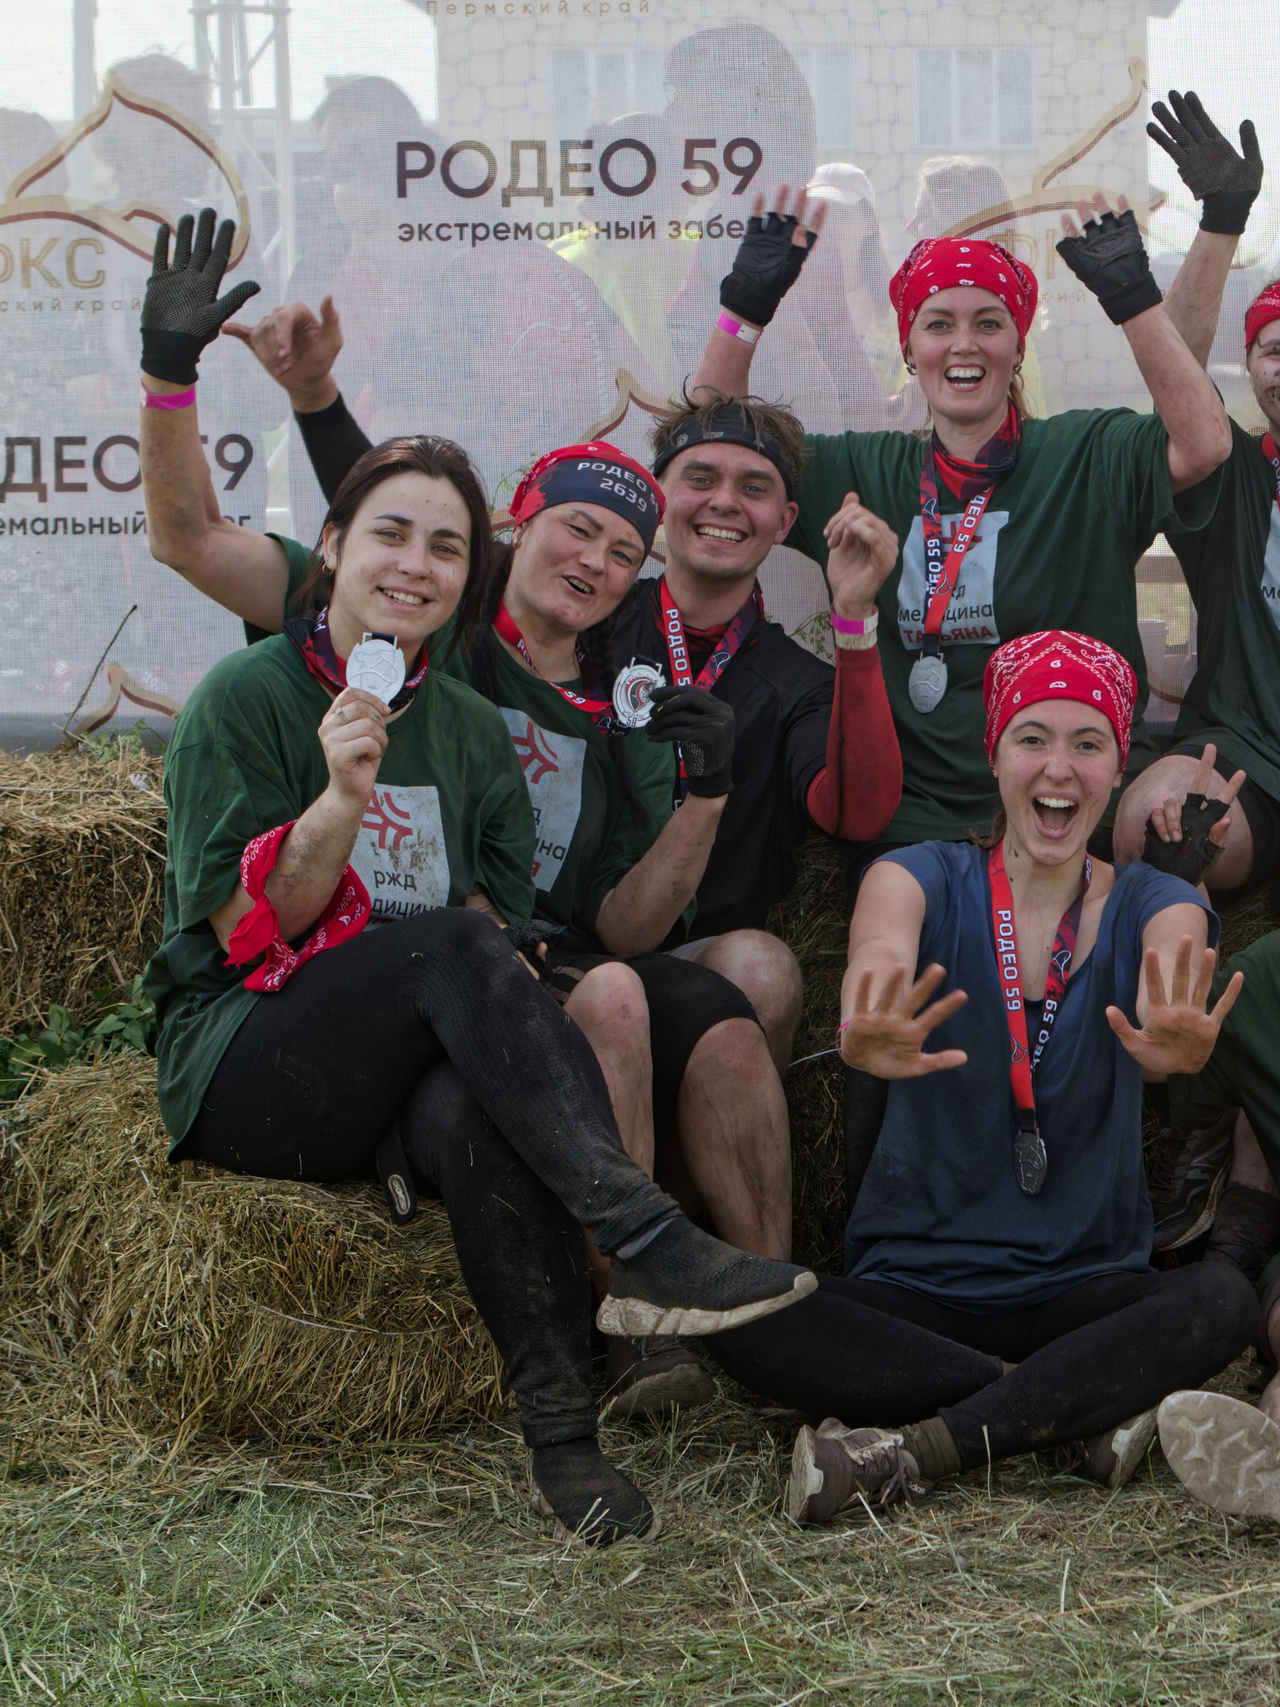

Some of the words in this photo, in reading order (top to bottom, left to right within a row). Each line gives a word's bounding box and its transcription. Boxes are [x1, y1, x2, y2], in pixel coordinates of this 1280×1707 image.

[426, 0, 569, 17] Пермский
[582, 0, 650, 17] край
[396, 138, 657, 207] РОДЕО
[681, 137, 763, 197] 59
[397, 214, 656, 247] экстремальный
[668, 213, 745, 240] забе
[0, 237, 106, 290] КС
[75, 297, 141, 315] край
[0, 434, 144, 502] ДЕО
[577, 462, 647, 492] РОДЕО
[600, 477, 648, 513] 2639
[927, 538, 941, 557] 59
[953, 532, 970, 554] 59
[898, 603, 993, 623] мецина
[666, 608, 689, 672] РОДЕО
[904, 626, 994, 644] ТАЬЯНА
[564, 690, 587, 705] 59
[626, 715, 638, 729] 59
[373, 870, 417, 892] ржд
[997, 909, 1018, 981] РОДЕО
[1005, 986, 1021, 1012] 59
[1043, 999, 1058, 1024] 59
